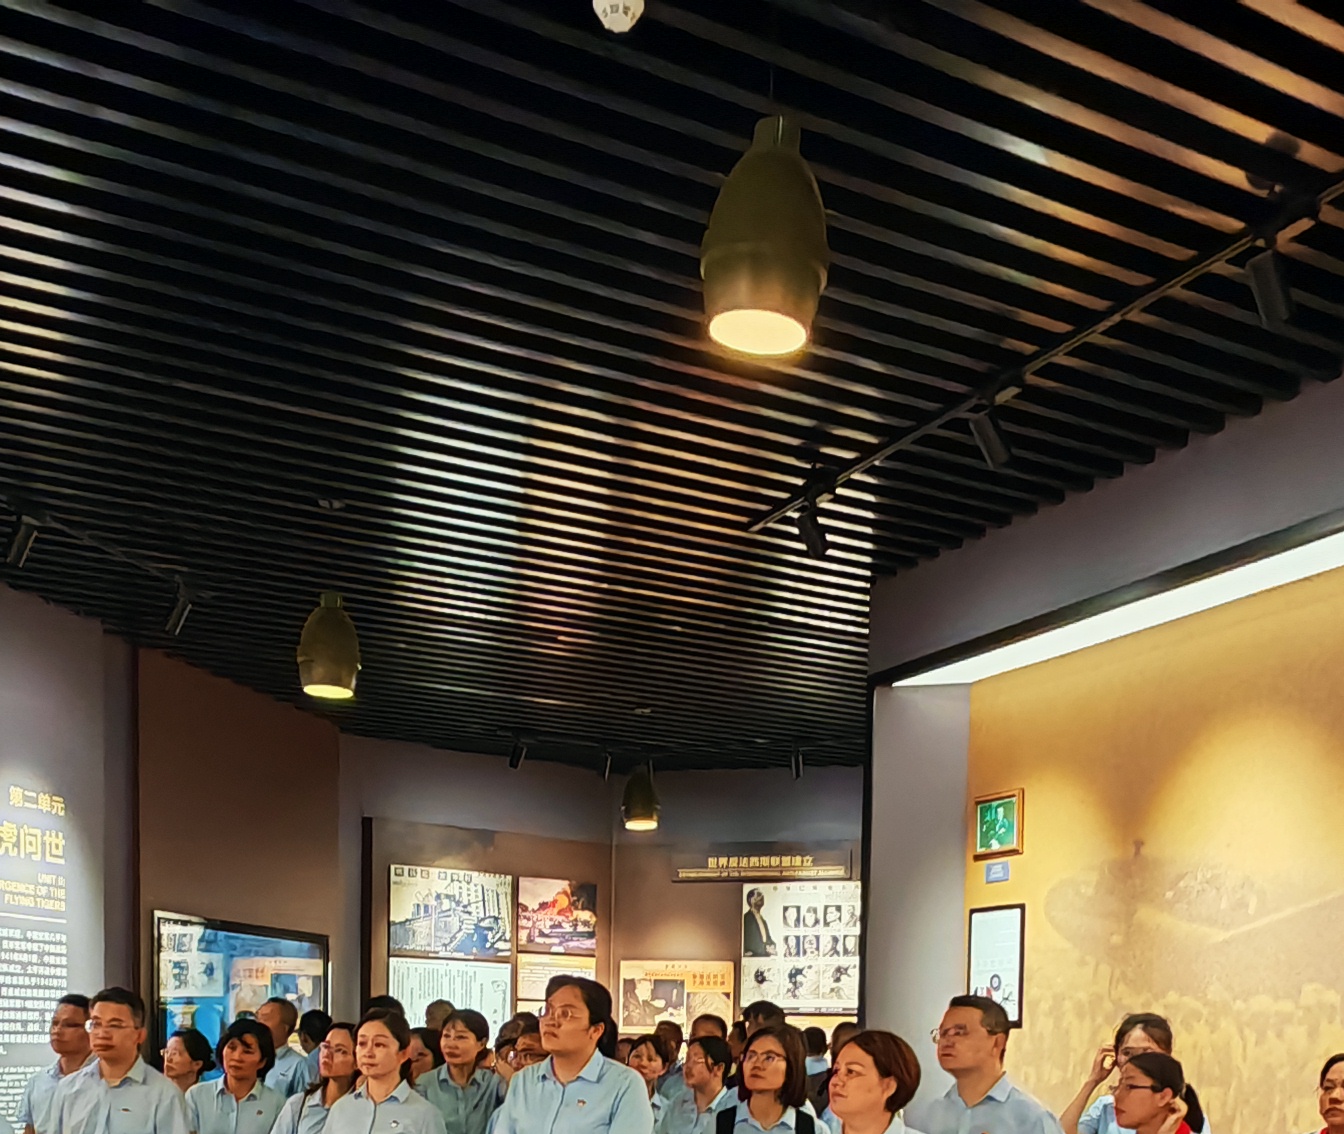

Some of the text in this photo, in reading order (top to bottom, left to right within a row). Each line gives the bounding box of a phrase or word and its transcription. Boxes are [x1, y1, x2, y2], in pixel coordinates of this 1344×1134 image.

[9, 785, 66, 817] 第二单元
[35, 884, 48, 898] OF
[3, 893, 35, 908] FLYING
